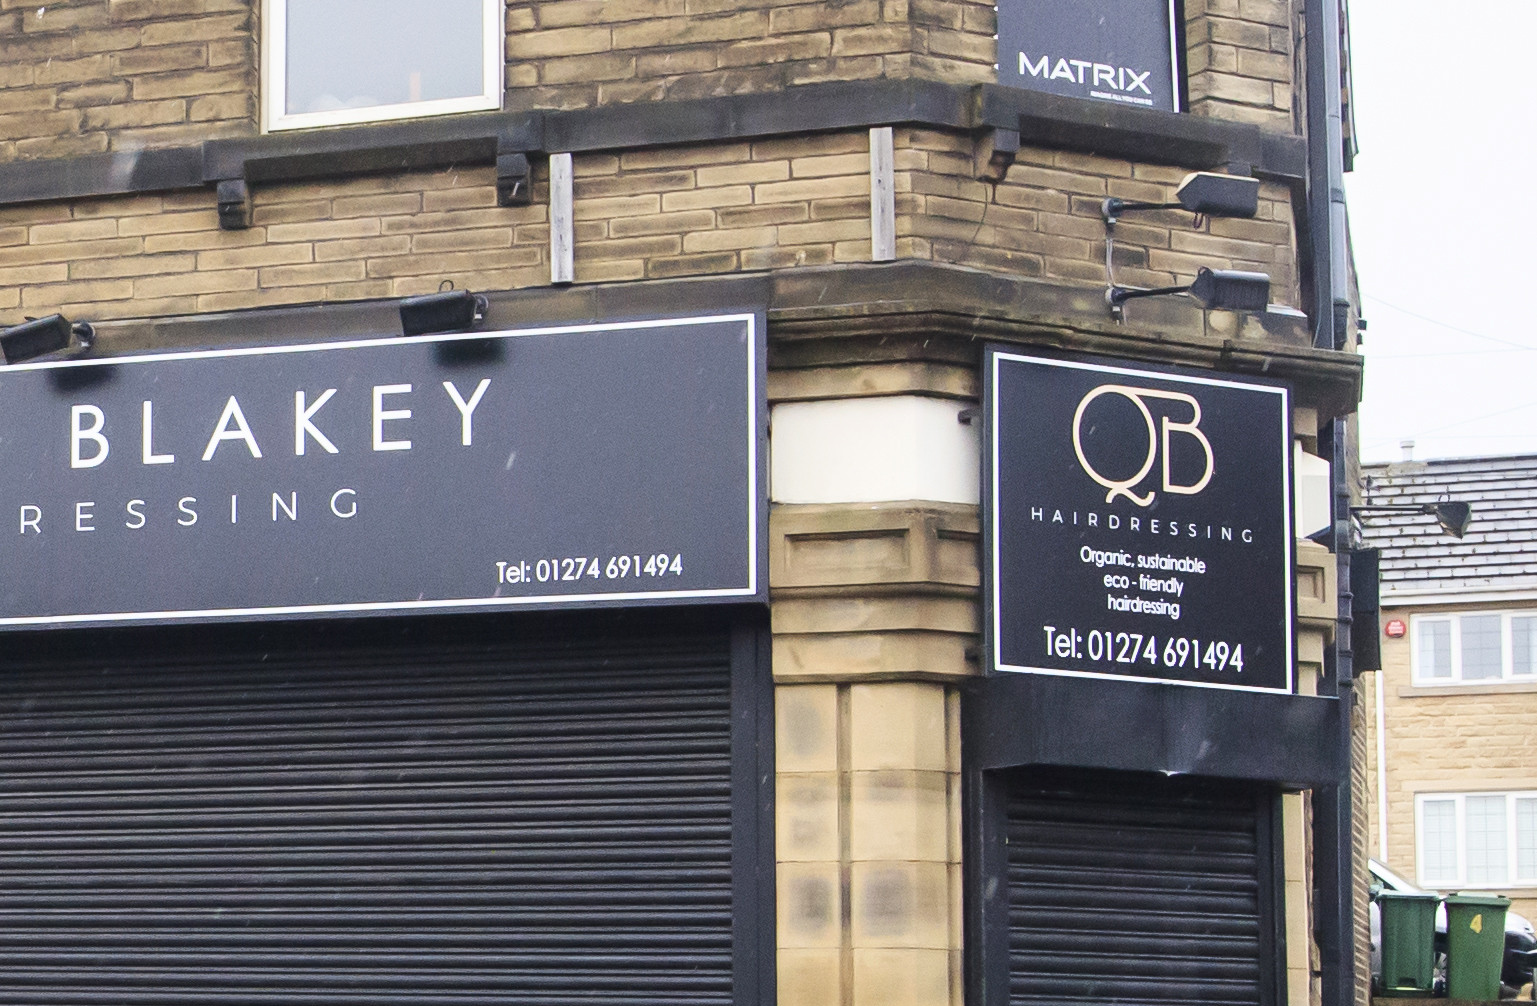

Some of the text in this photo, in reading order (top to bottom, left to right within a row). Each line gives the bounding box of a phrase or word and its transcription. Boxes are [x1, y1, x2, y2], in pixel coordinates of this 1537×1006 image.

[1018, 51, 1152, 94] MATRIX
[69, 378, 492, 469] BLAKEY
[1072, 384, 1214, 507] QB
[1030, 506, 1254, 543] HAIRDRESSING
[496, 553, 683, 585] Tel: 01274 691494
[1080, 545, 1206, 574] Organic, sustainable
[1103, 576, 1129, 589] eco
[1139, 575, 1183, 597] friendly
[1107, 593, 1181, 620] hairdressing
[1044, 625, 1244, 673] Tel: 01274 691494
